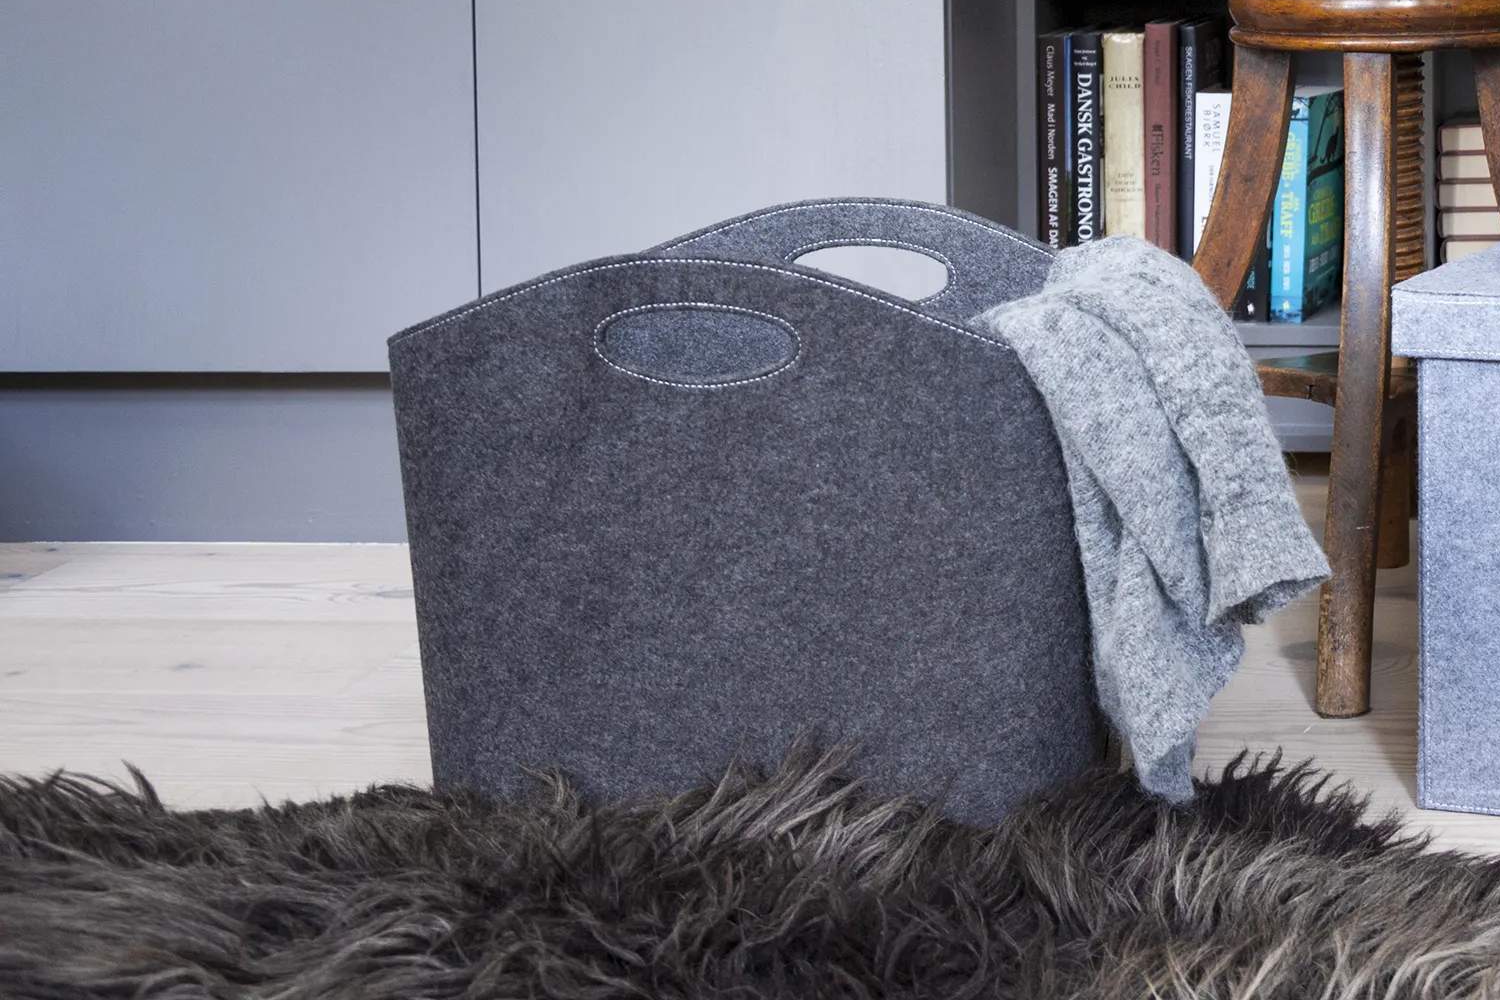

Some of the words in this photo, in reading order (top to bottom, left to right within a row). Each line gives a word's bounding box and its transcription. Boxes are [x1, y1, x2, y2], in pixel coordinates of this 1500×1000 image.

[1046, 46, 1054, 68] Claus
[1045, 71, 1055, 96] Meyer
[1047, 103, 1055, 121] Mad
[1077, 73, 1092, 134] DANSK
[1202, 110, 1211, 147] BJØRK
[1047, 129, 1056, 160] Norden
[1048, 167, 1057, 212] SMAGEN
[1049, 214, 1058, 227] AF
